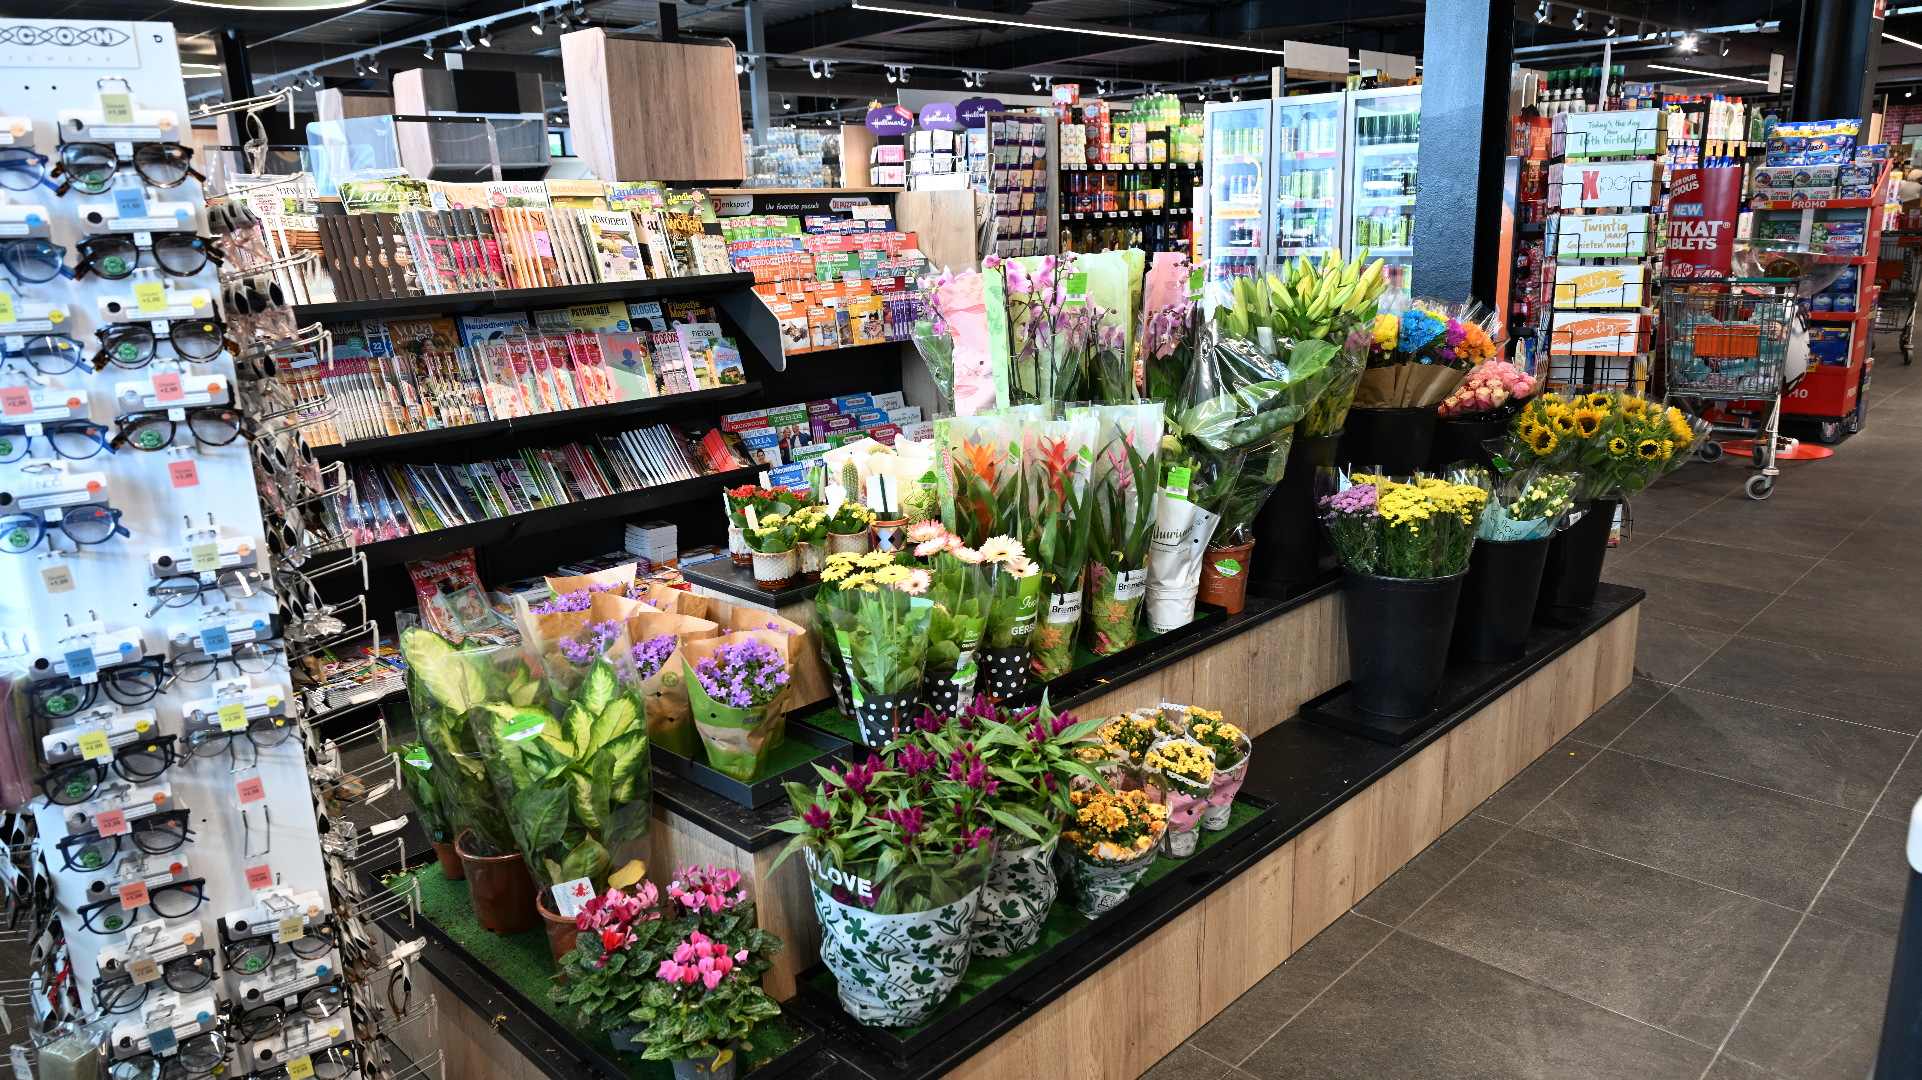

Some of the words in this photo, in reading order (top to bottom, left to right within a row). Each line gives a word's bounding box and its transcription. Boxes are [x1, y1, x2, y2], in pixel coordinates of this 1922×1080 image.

[923, 115, 953, 124] Hallmark
[962, 111, 986, 121] Hallm
[871, 117, 907, 127] Hallmark
[1588, 121, 1612, 129] Today's
[1615, 119, 1626, 127] the
[1627, 119, 1640, 128] day
[1580, 132, 1600, 147] 16th
[1603, 133, 1648, 147] birthday!
[1769, 143, 1785, 153] Dash
[1857, 150, 1871, 158] Dash
[1682, 173, 1697, 183] OUR
[611, 185, 661, 197] landleven
[1580, 170, 1643, 201] Xpert
[669, 192, 706, 202] landleven
[777, 202, 799, 210] favoriete
[1673, 204, 1702, 216] NEW
[589, 214, 628, 226] vtwonen
[1582, 218, 1629, 237] Twintig
[1567, 240, 1605, 250] Genieten
[1607, 239, 1635, 249] maar!
[667, 301, 700, 311] Filosofie
[465, 318, 528, 331] Neurodiversiteit?
[393, 322, 434, 341] yoga
[373, 342, 383, 350] 22
[774, 412, 802, 423] ZWEEDS
[412, 557, 470, 580] happinez
[817, 859, 873, 898] LOVE
